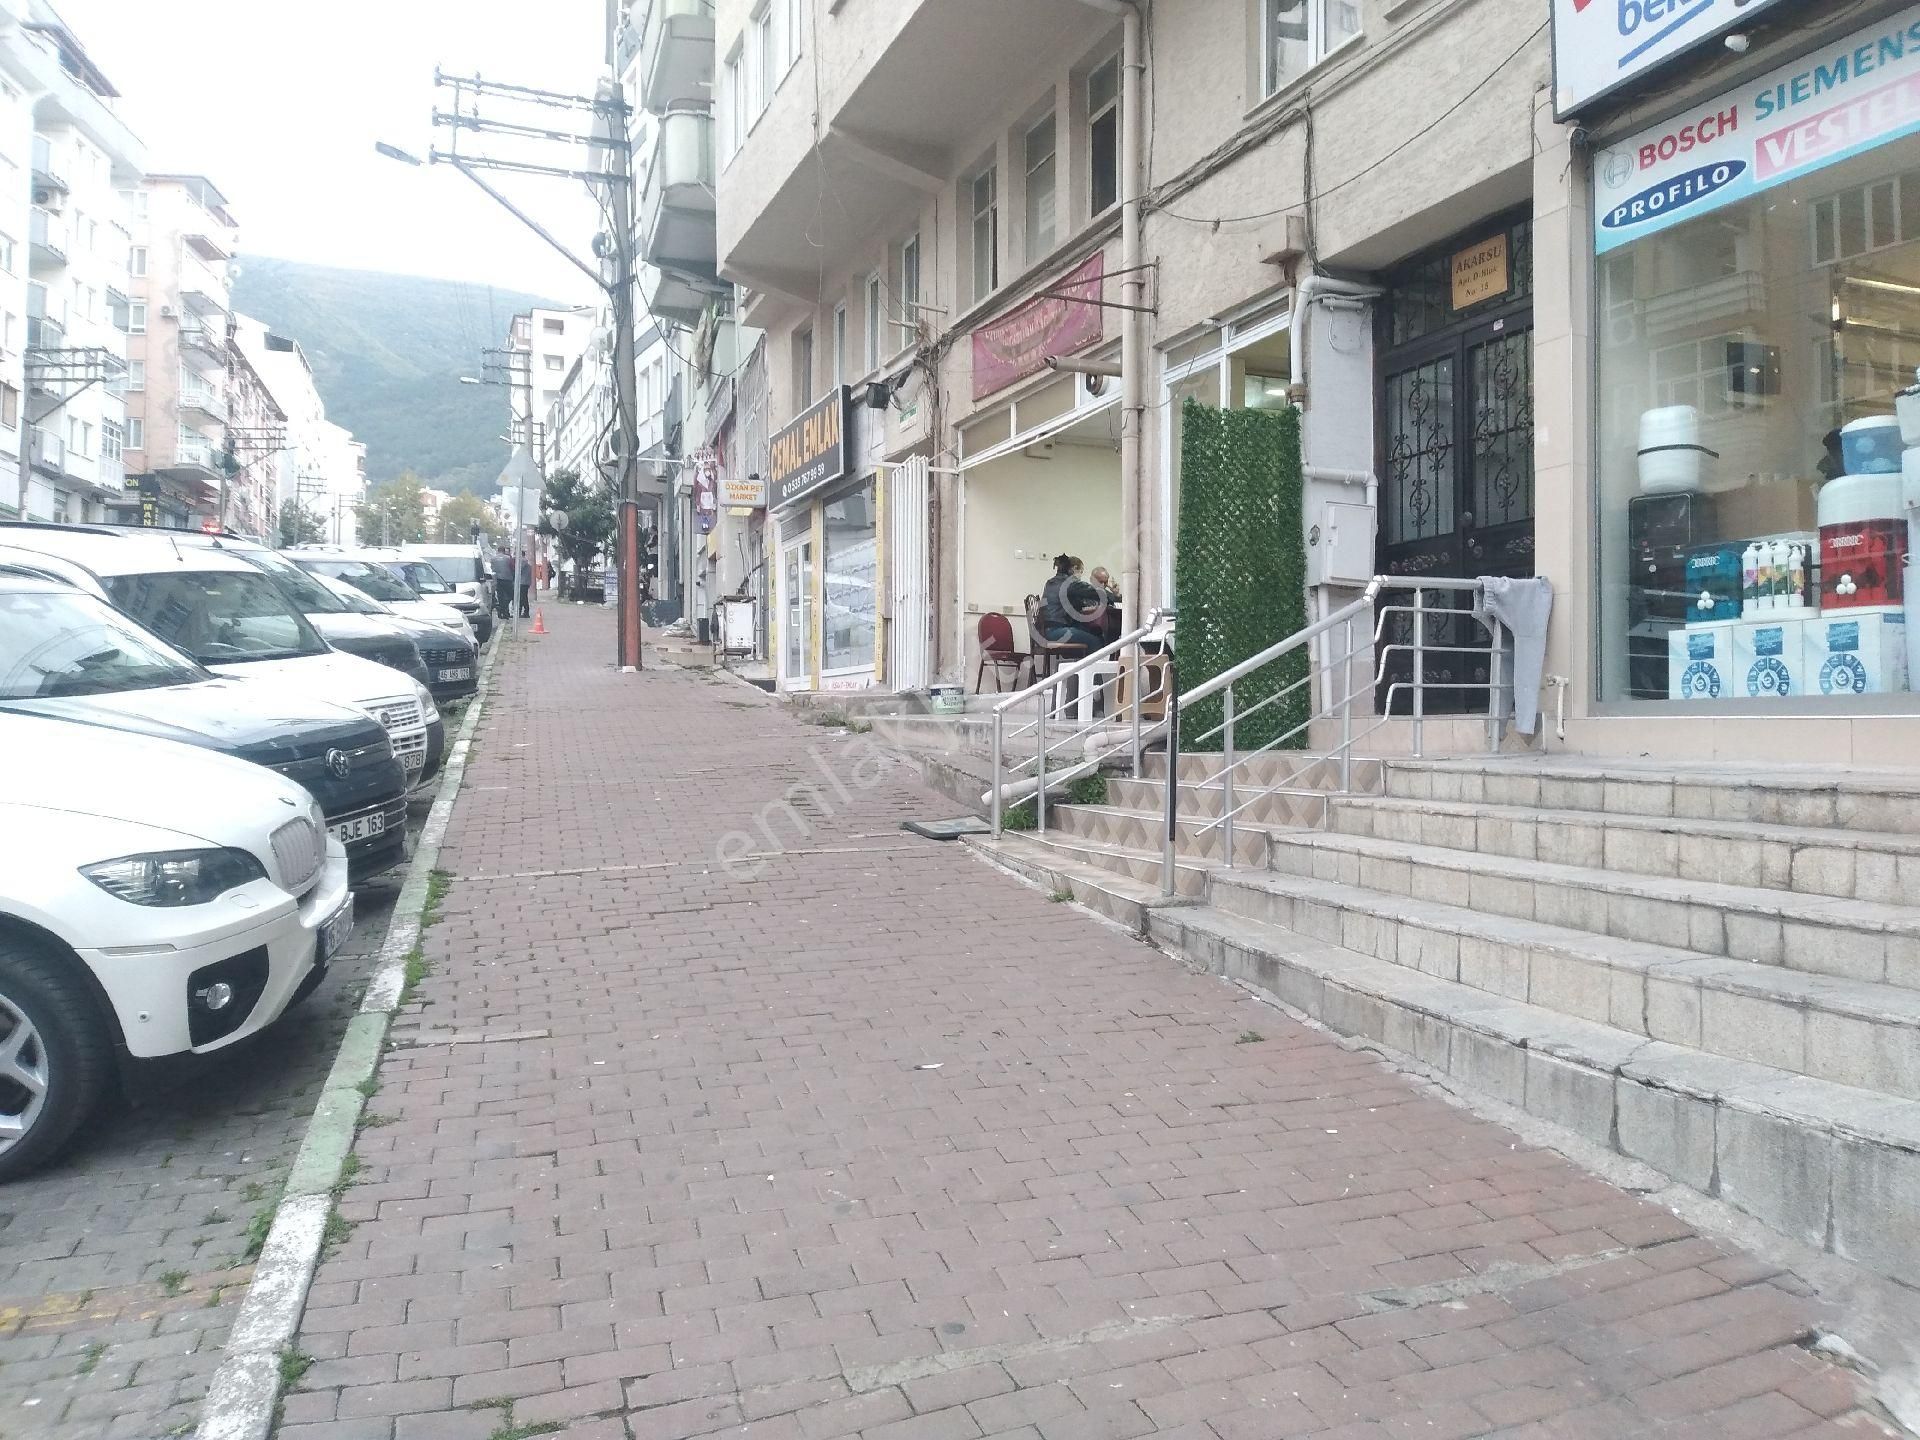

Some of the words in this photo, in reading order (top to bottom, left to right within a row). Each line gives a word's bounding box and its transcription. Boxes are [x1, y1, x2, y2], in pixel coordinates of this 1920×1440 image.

[1638, 105, 1738, 170] BOSCH
[1456, 244, 1502, 274] AKARSU
[771, 427, 802, 483] CEMAL
[803, 399, 839, 464] EMLAK
[729, 493, 757, 501] MARKET
[404, 754, 421, 769] 878
[340, 817, 362, 842] BJE
[367, 815, 384, 834] 163
